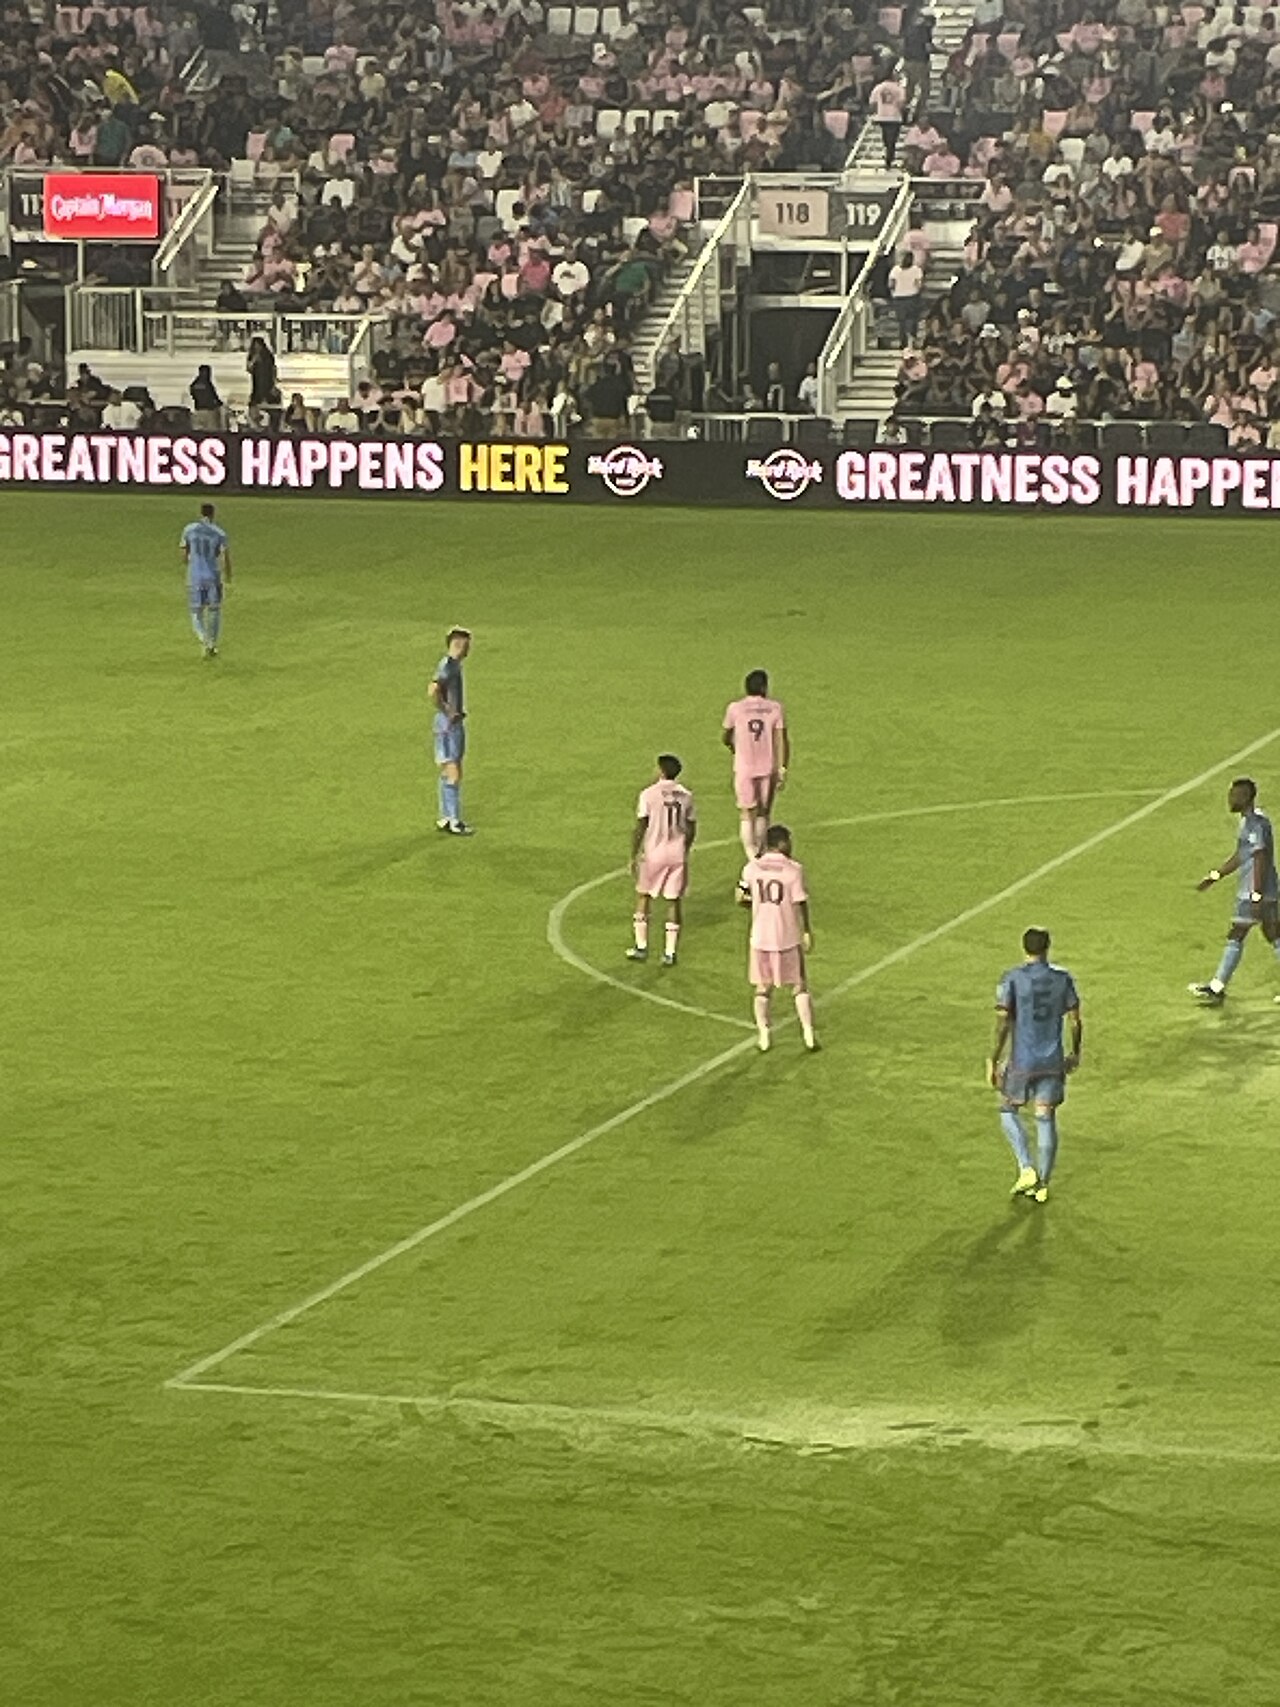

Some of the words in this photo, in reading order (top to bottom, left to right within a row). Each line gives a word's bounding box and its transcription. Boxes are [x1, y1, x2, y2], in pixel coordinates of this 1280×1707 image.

[21, 194, 44, 215] 11
[776, 202, 810, 224] 118
[846, 203, 881, 225] 119
[241, 438, 444, 490] HAPPENS
[459, 444, 569, 493] HERE
[836, 451, 1100, 503] GREATNESS
[747, 719, 764, 742] 9
[756, 878, 784, 905] 10
